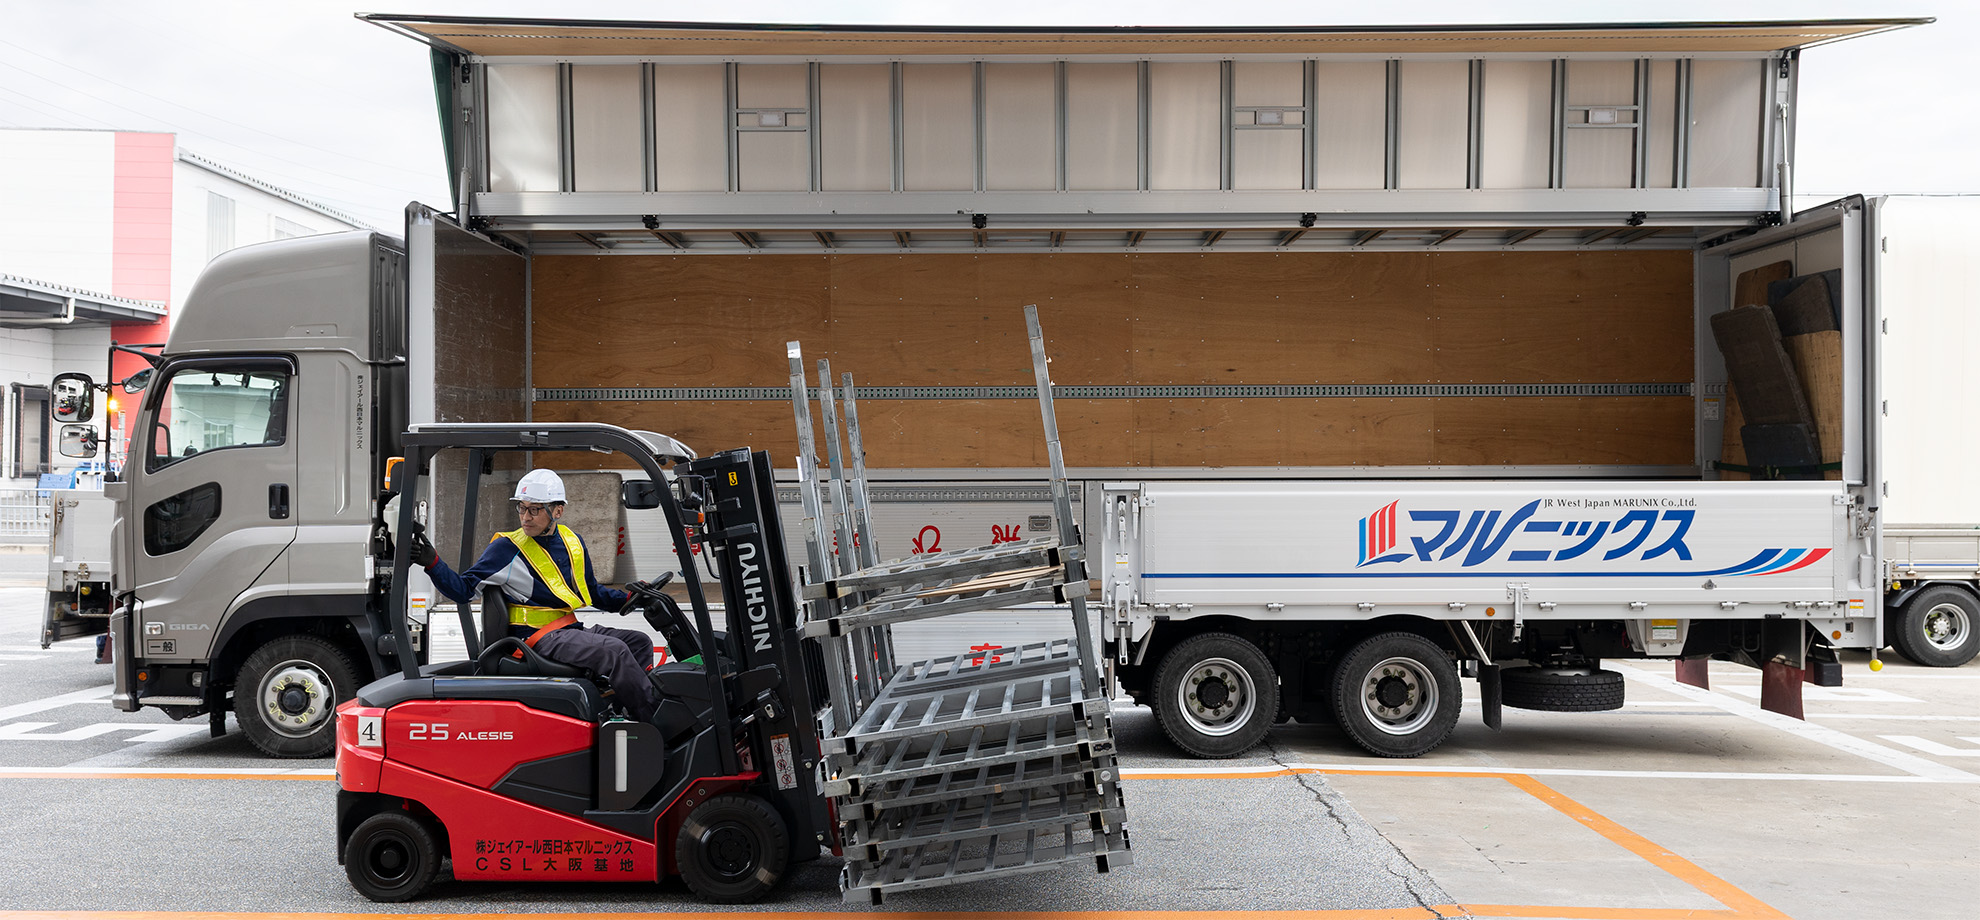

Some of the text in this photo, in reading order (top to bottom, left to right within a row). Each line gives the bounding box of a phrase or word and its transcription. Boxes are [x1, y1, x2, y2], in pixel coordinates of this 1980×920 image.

[1544, 498, 1697, 510] JR West Japan MARUNIX Co.,Ltd.
[1408, 498, 1696, 567] マルニックス
[736, 542, 773, 653] NICHIYU
[169, 623, 210, 631] GIGA
[150, 641, 173, 653] 一般
[362, 721, 376, 741] 4
[409, 723, 514, 741] 25 ALESIS
